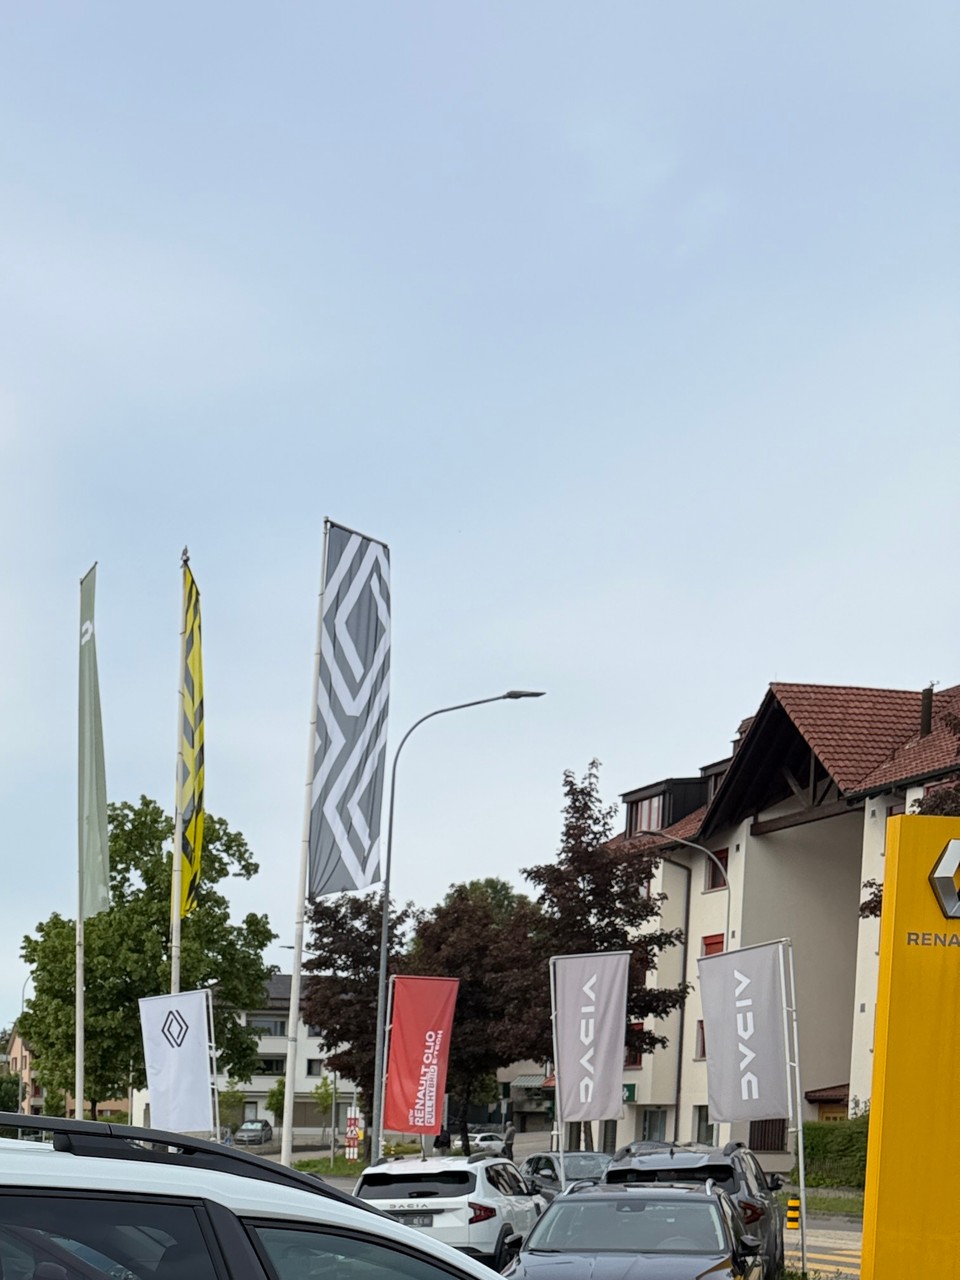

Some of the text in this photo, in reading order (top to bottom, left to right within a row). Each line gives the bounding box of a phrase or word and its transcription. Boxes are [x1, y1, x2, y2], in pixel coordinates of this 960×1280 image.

[907, 931, 960, 947] RENA
[415, 1031, 436, 1126] RENAULT CLIO
[579, 974, 597, 1103] DACIA
[733, 969, 759, 1101] DACIA
[426, 1066, 437, 1125] FULL HYBRID
